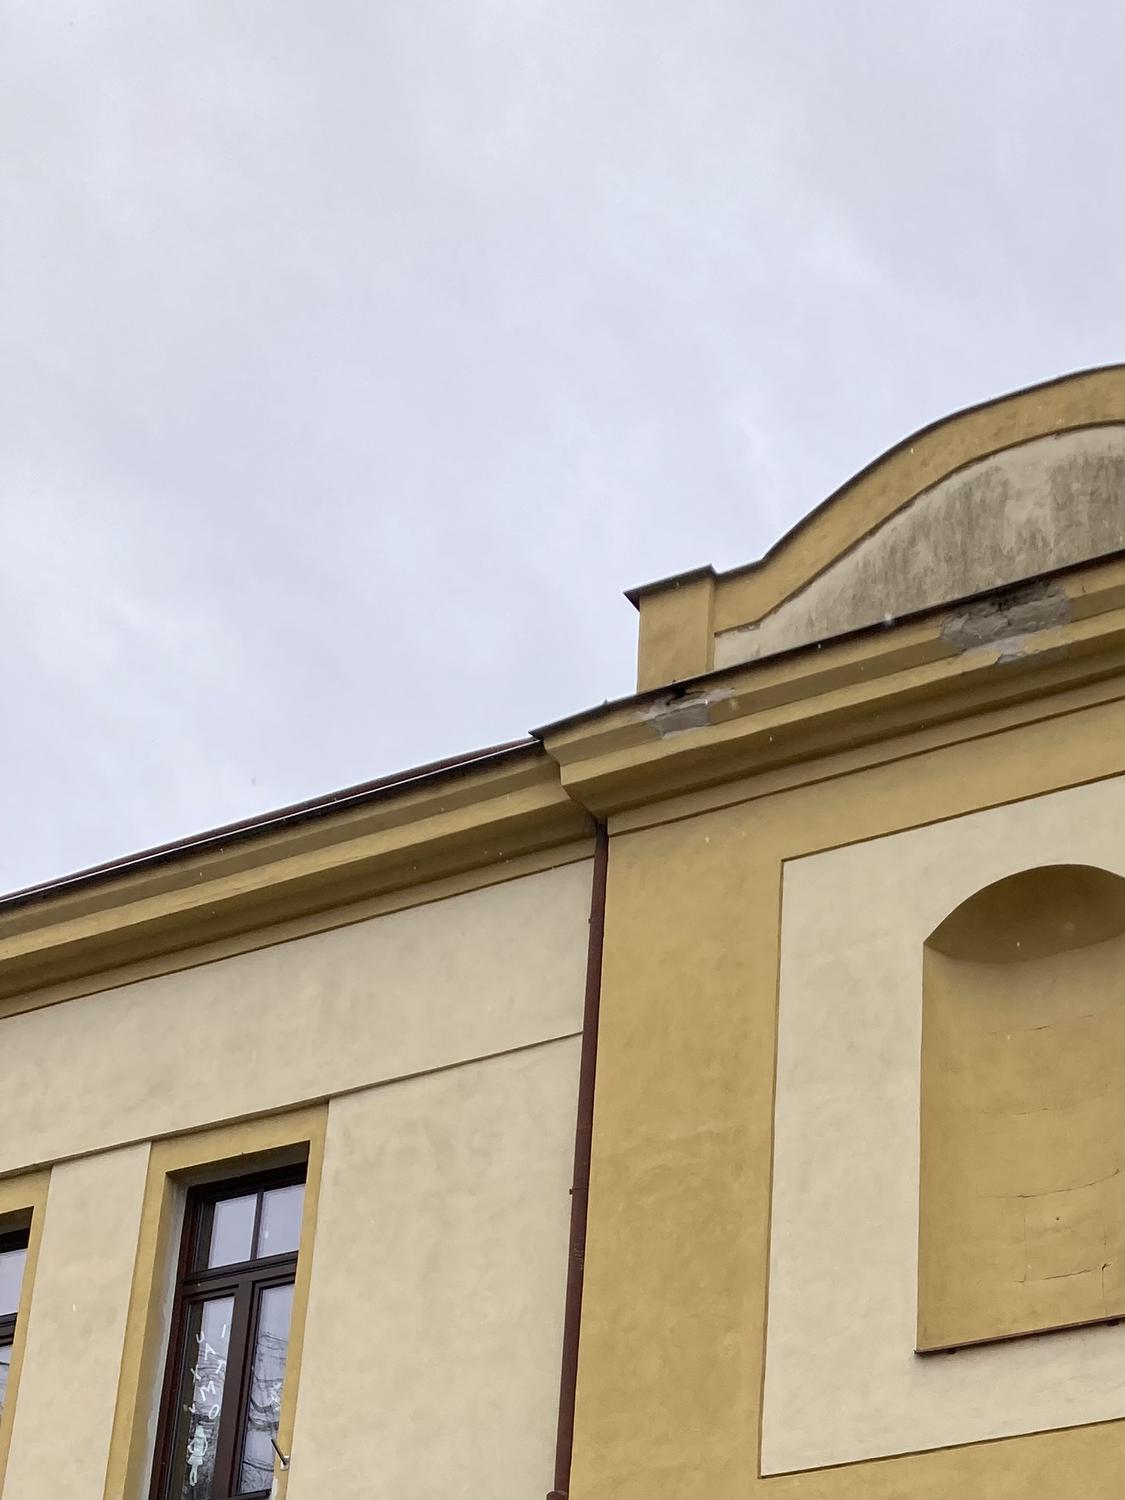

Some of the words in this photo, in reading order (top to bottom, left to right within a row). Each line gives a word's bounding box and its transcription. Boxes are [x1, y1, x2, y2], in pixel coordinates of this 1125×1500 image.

[204, 1342, 217, 1361] A
[199, 1380, 216, 1402] M
[208, 1404, 220, 1420] O
